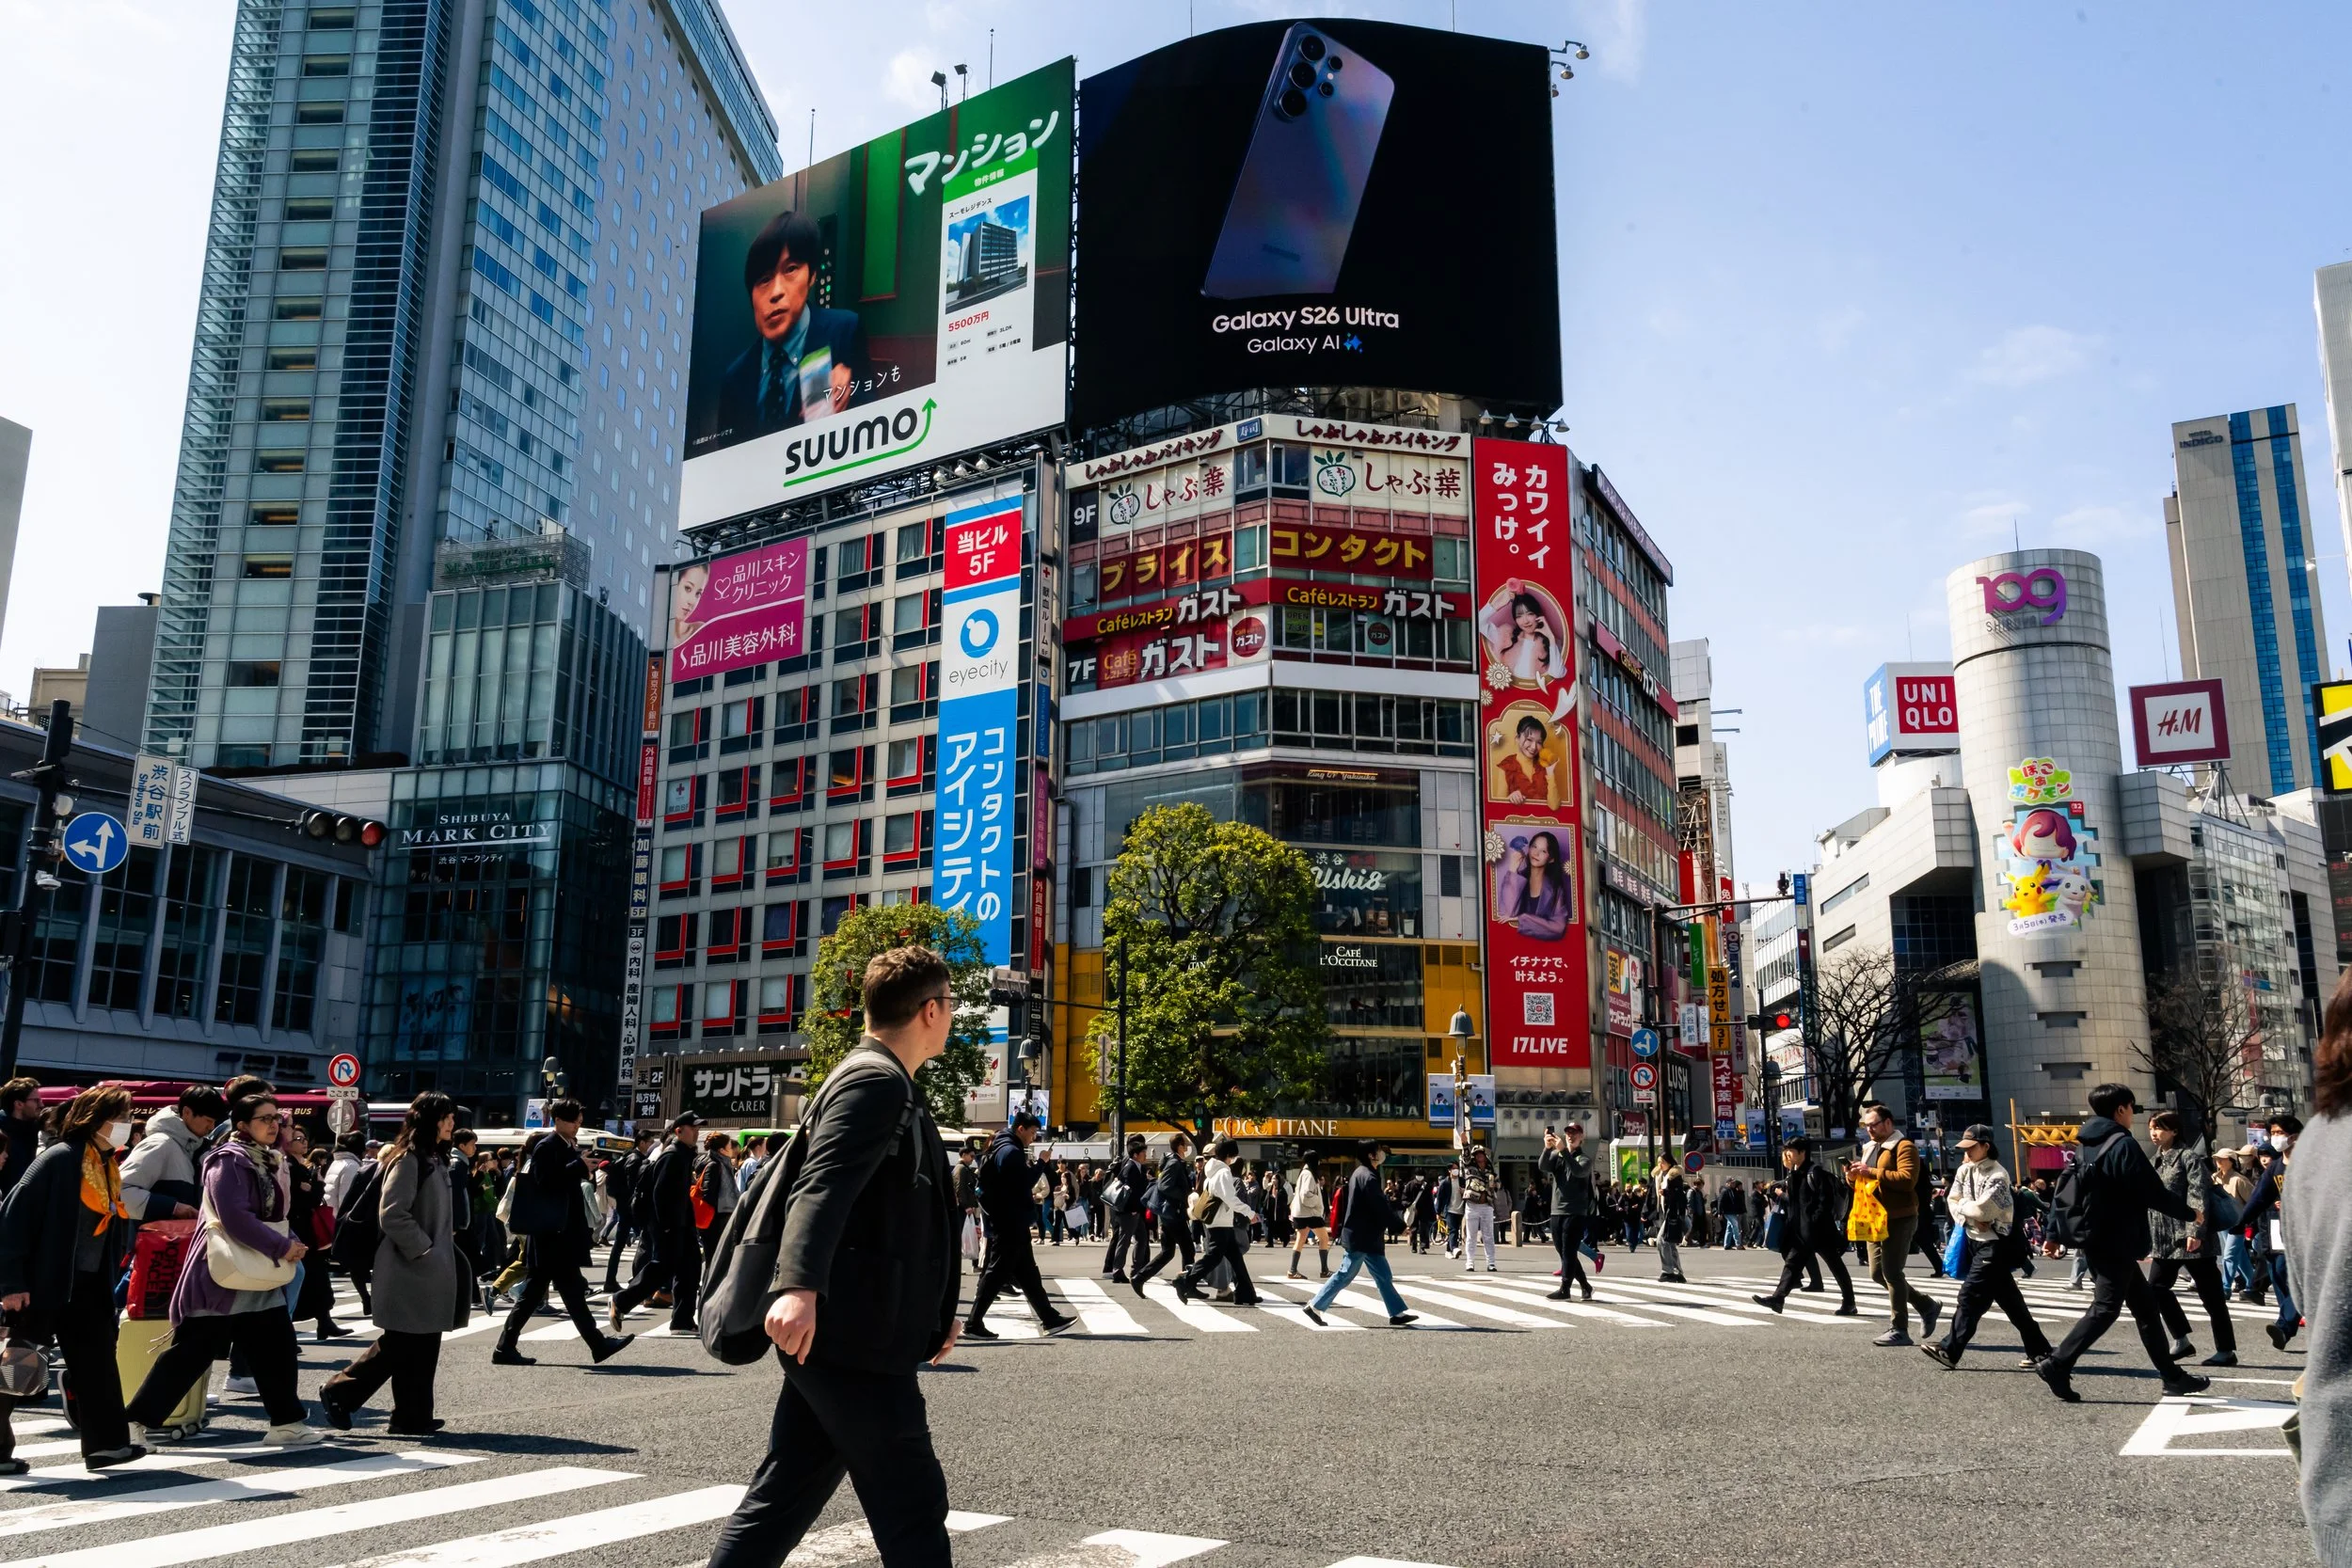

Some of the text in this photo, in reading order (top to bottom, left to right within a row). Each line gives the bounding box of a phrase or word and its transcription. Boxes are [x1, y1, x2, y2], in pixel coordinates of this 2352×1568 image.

[905, 110, 1059, 197] マンション
[949, 198, 993, 218] スーモレジデンス
[948, 310, 990, 332] 5500万円
[1213, 307, 1399, 333] Galaxy S26 Ultra
[1248, 335, 1340, 354] Galaxy AI
[823, 365, 901, 403] マンションも
[1239, 423, 1259, 437] 寿司
[1296, 420, 1461, 451] しゃぶしゃぶバイキング
[2179, 435, 2223, 449] INDIGO
[1085, 429, 1223, 480] しゃぶしゃぶバイキング
[1146, 466, 1225, 511] しゃぶ葉
[1366, 462, 1461, 499] しゃぶ葉
[1073, 504, 1097, 526] 9F
[1492, 462, 1519, 555] みっけ。
[1525, 464, 1551, 569] カワイイ
[957, 524, 1009, 554] 当ビル
[1272, 530, 1426, 568] コンタクト
[732, 551, 801, 584] 品川スキン
[969, 550, 996, 577] 5F
[1103, 538, 1228, 592] プライス
[732, 574, 792, 605] クリニック
[1976, 568, 2067, 626] 109
[1178, 588, 1241, 626] ガスト
[1383, 590, 1454, 620] ガスト
[690, 622, 796, 667] 品川美容外科
[1236, 634, 1263, 647] ガスト
[1371, 631, 1389, 641] ガスト
[1104, 649, 1137, 670] Café
[1141, 633, 1219, 678] ガスト
[949, 660, 1009, 687] eyecity
[1069, 657, 1097, 682] 7F
[647, 671, 660, 729] 東京スター銀行
[1903, 684, 1947, 703] UNI
[1905, 706, 1953, 730] QLO
[2157, 706, 2201, 736] H&M
[643, 747, 655, 786] 外貨両替
[2022, 760, 2054, 778] ぽこ
[135, 773, 149, 807] Shibuya
[2011, 783, 2070, 800] ポケモン
[2034, 776, 2047, 787] あ
[142, 764, 168, 840] 渋谷駅前
[172, 770, 193, 842] スクランブル式
[439, 813, 511, 824] SHIBUYA
[941, 732, 977, 912] アイシティ
[977, 727, 1005, 921] コンタクトの
[401, 824, 552, 844] MARK CITY
[438, 854, 503, 864] 渋谷 マークシティ
[632, 838, 650, 903] 加藤眼科
[1315, 852, 1344, 865] 渋谷
[1310, 866, 1383, 891] Ushi8
[1035, 879, 1043, 928] 外貨両替
[630, 928, 644, 937] 3F
[628, 957, 641, 978] 内科
[1509, 956, 1568, 969] イチナナで、
[1515, 970, 1564, 983] 叶えよう。
[1710, 970, 1726, 1022] 処方せん
[1686, 1007, 1695, 1043] 渋谷駅前
[1513, 1037, 1568, 1053] 17LIVE
[637, 1069, 648, 1085] 薬
[1667, 1063, 1689, 1092] LUSH
[1715, 1057, 1733, 1117] スギ薬局
[329, 1089, 358, 1099] ここまで
[635, 1089, 661, 1103] 処方せん
[731, 1100, 766, 1112] CARER
[294, 1107, 312, 1116] BUS
[642, 1104, 656, 1117] 受付
